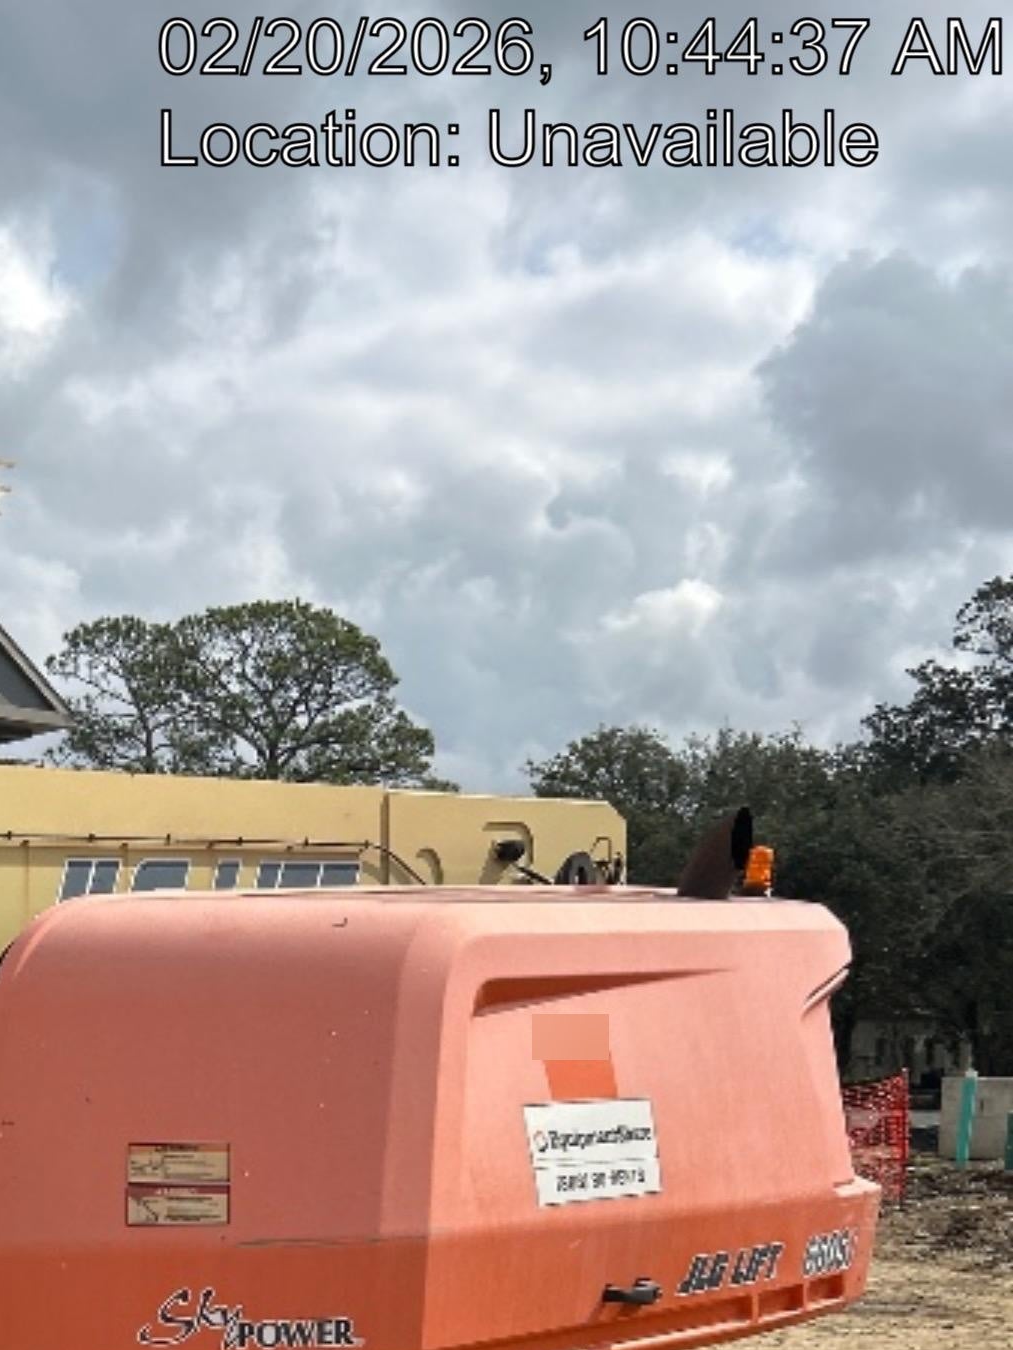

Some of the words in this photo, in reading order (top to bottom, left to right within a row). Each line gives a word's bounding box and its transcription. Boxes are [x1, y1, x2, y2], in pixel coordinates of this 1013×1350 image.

[675, 1253, 730, 1296] JLG
[729, 1241, 786, 1287] LIFT
[236, 1316, 356, 1350] POWER
